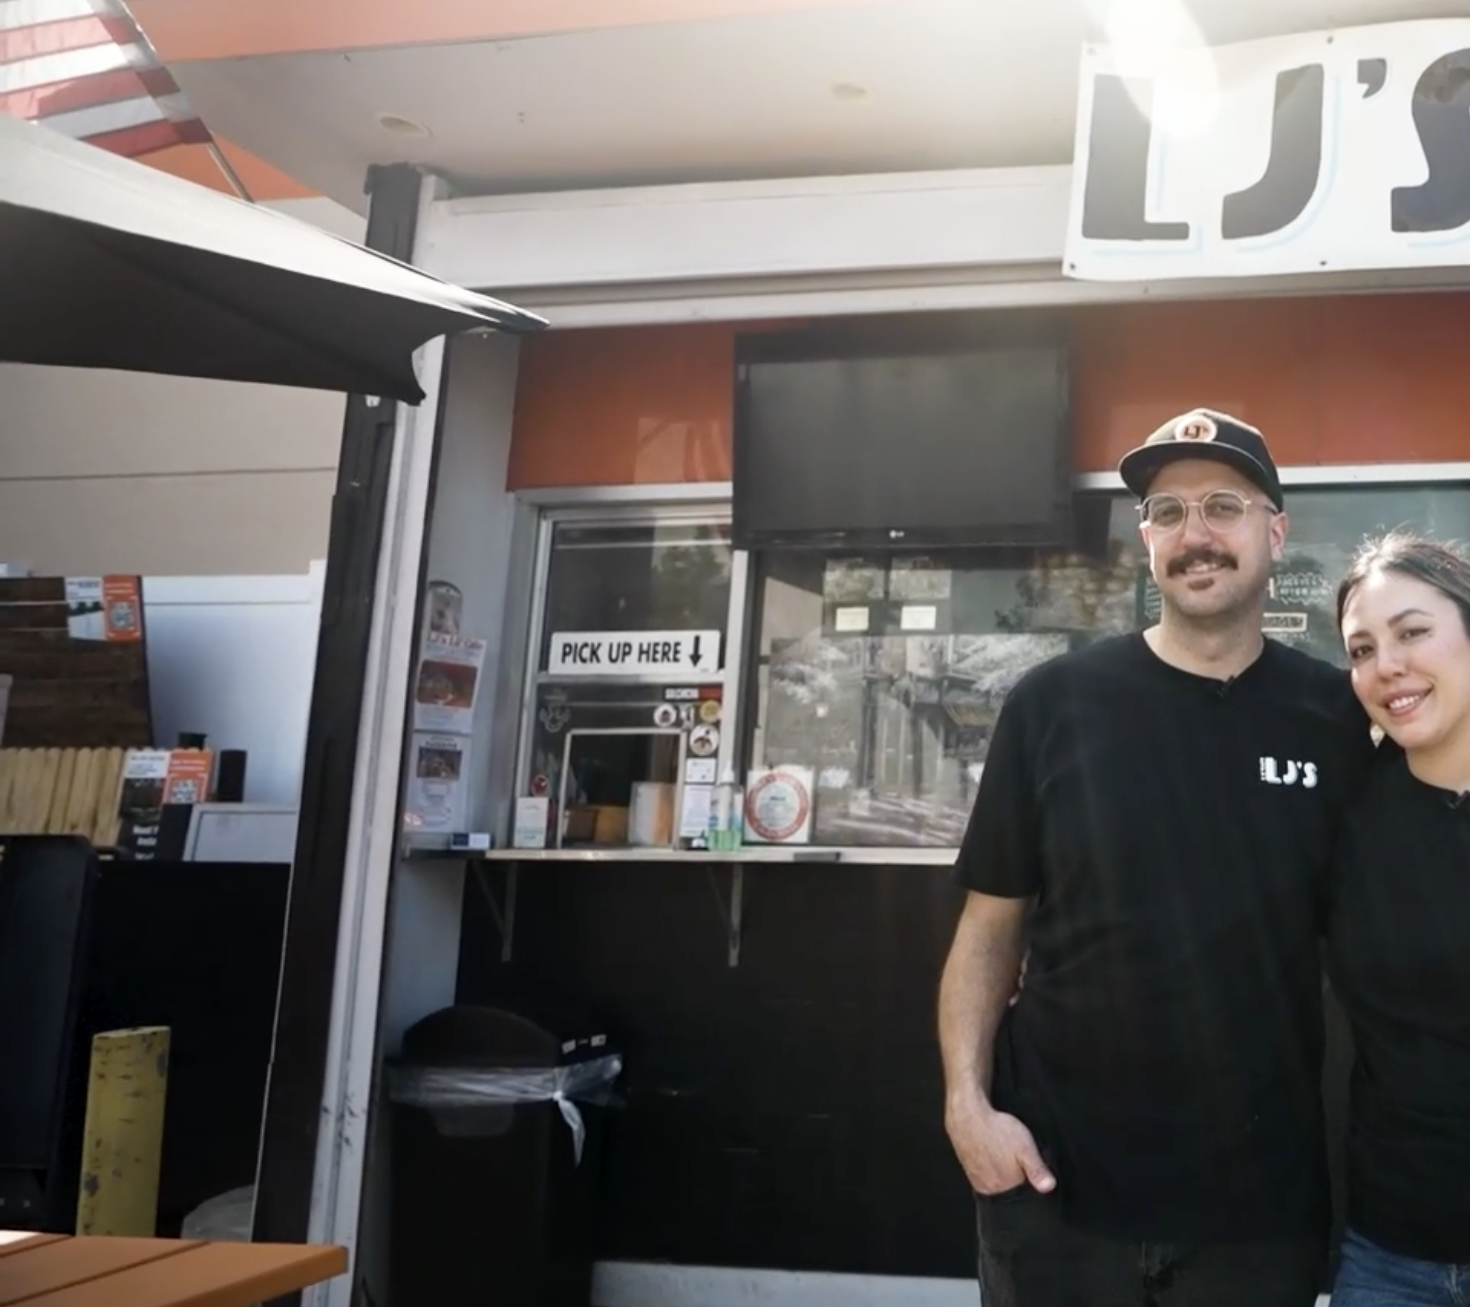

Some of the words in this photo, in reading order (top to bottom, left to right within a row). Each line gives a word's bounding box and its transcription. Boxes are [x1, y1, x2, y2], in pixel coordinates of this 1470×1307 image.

[561, 641, 601, 665] PICK
[607, 641, 633, 664] UP
[637, 640, 682, 664] HERE
[1264, 756, 1318, 789] LJ'S
